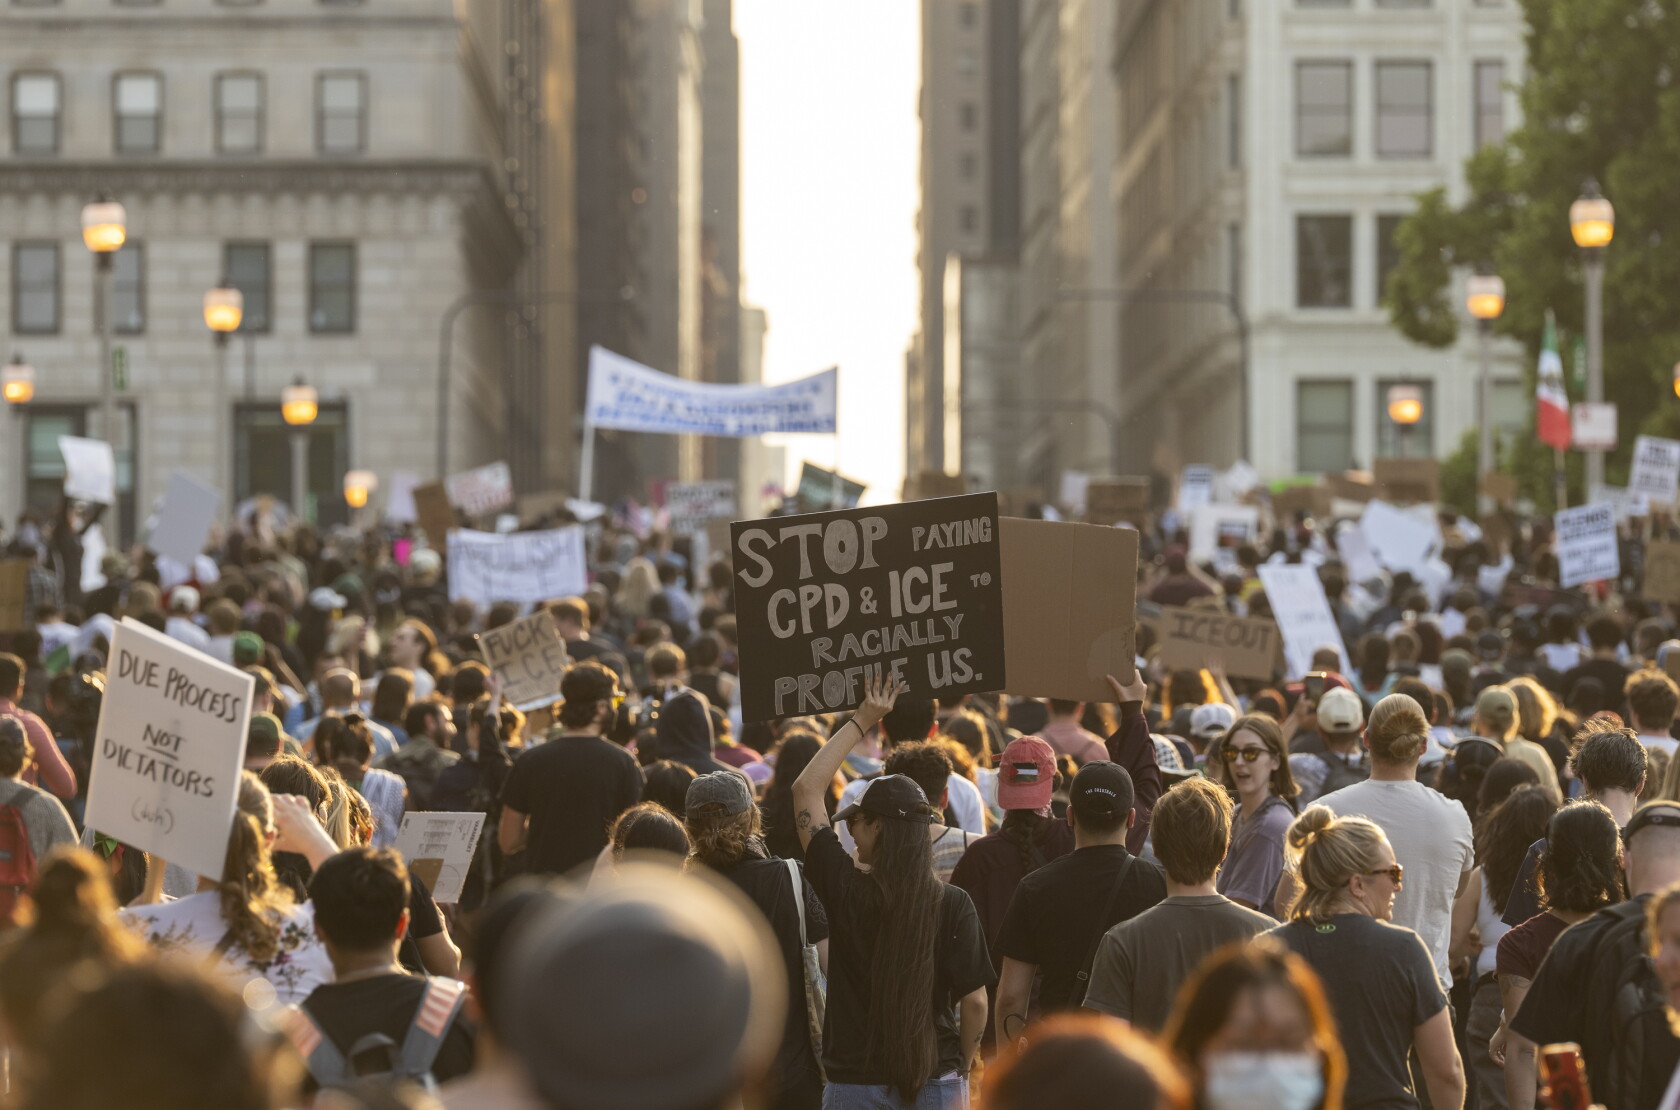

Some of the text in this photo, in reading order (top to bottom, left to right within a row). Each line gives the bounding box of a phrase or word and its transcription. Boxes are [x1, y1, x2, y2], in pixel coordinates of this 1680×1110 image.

[738, 516, 992, 588] STOP PAYING
[767, 562, 991, 639] CPD & ICE TO
[485, 617, 550, 660] FUCK
[493, 643, 562, 689] ICE
[811, 614, 964, 669] RACIALLY
[119, 649, 242, 723] DUE PROCESS
[927, 647, 983, 689] US.
[142, 723, 187, 753] NOT
[103, 738, 215, 798] DICTATORS
